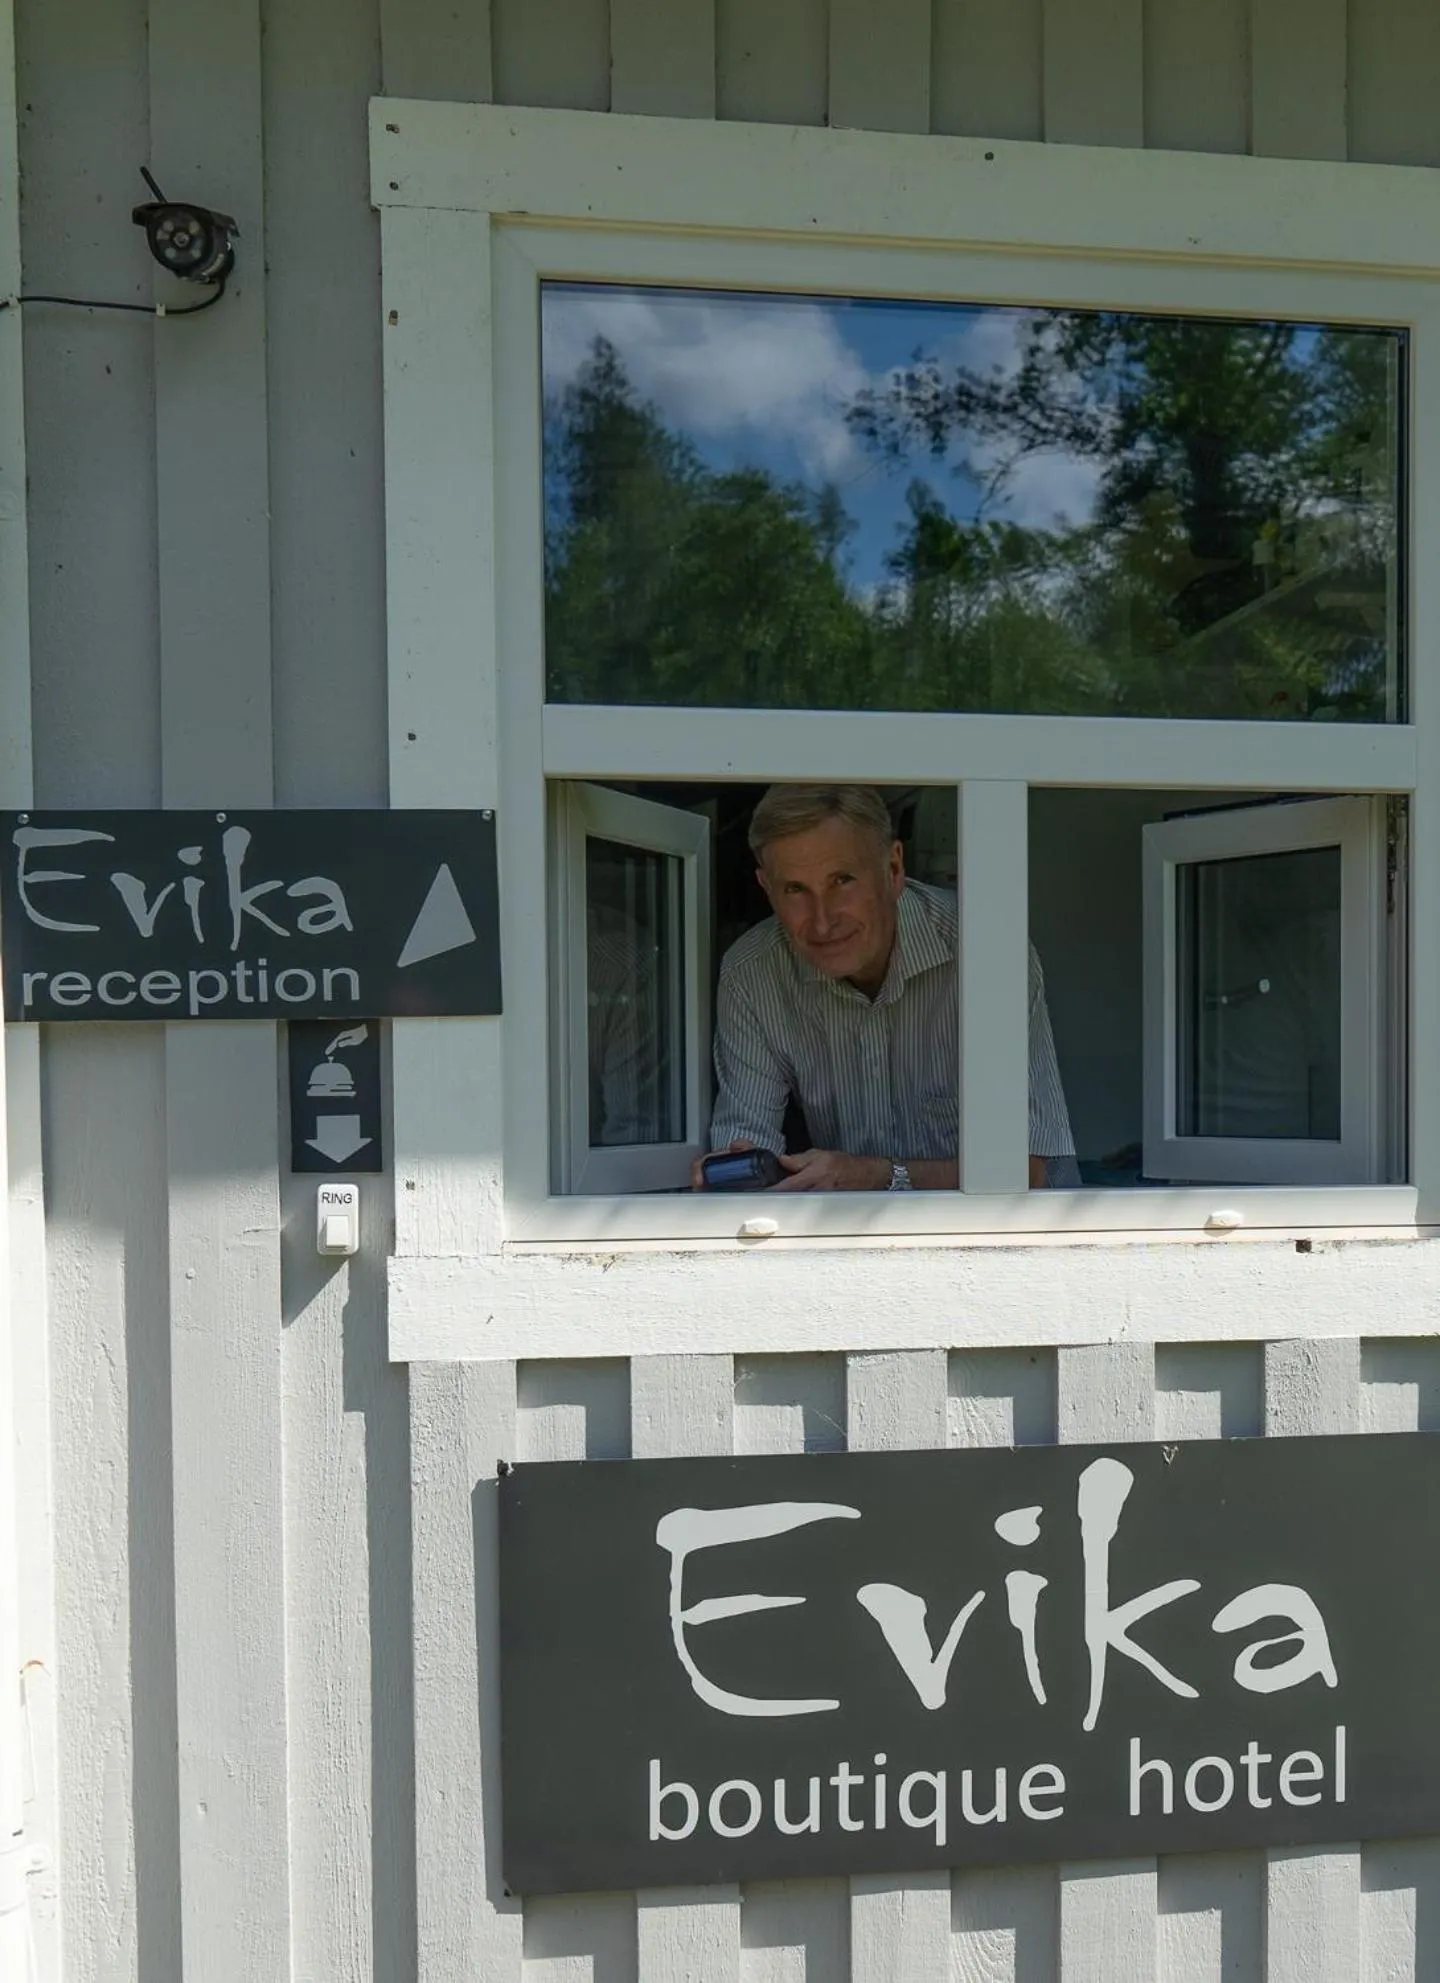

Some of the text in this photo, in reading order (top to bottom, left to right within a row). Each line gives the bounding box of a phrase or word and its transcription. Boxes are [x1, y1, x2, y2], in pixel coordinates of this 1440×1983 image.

[12, 826, 354, 952] Evika
[22, 957, 361, 1016] reception
[322, 1192, 353, 1205] RING
[655, 1457, 1338, 1732] Evika
[648, 1725, 1348, 1847] boutique hotel
